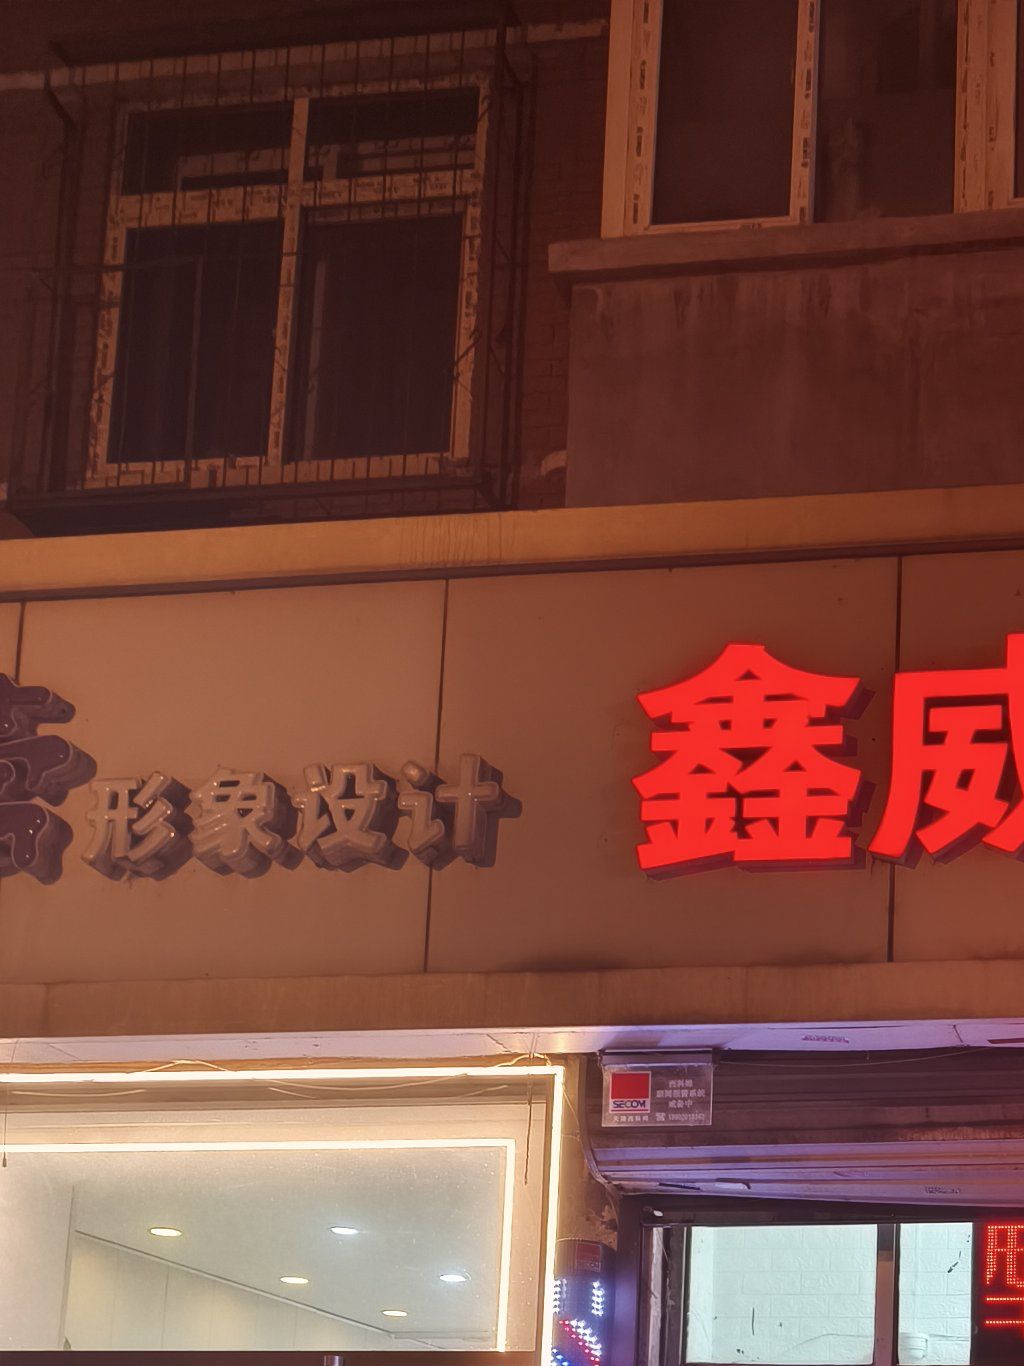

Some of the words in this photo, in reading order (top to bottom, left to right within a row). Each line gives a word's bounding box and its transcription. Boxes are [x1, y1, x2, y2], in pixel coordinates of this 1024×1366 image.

[82, 754, 512, 876] 形象设计
[612, 1100, 646, 1109] SECOM
